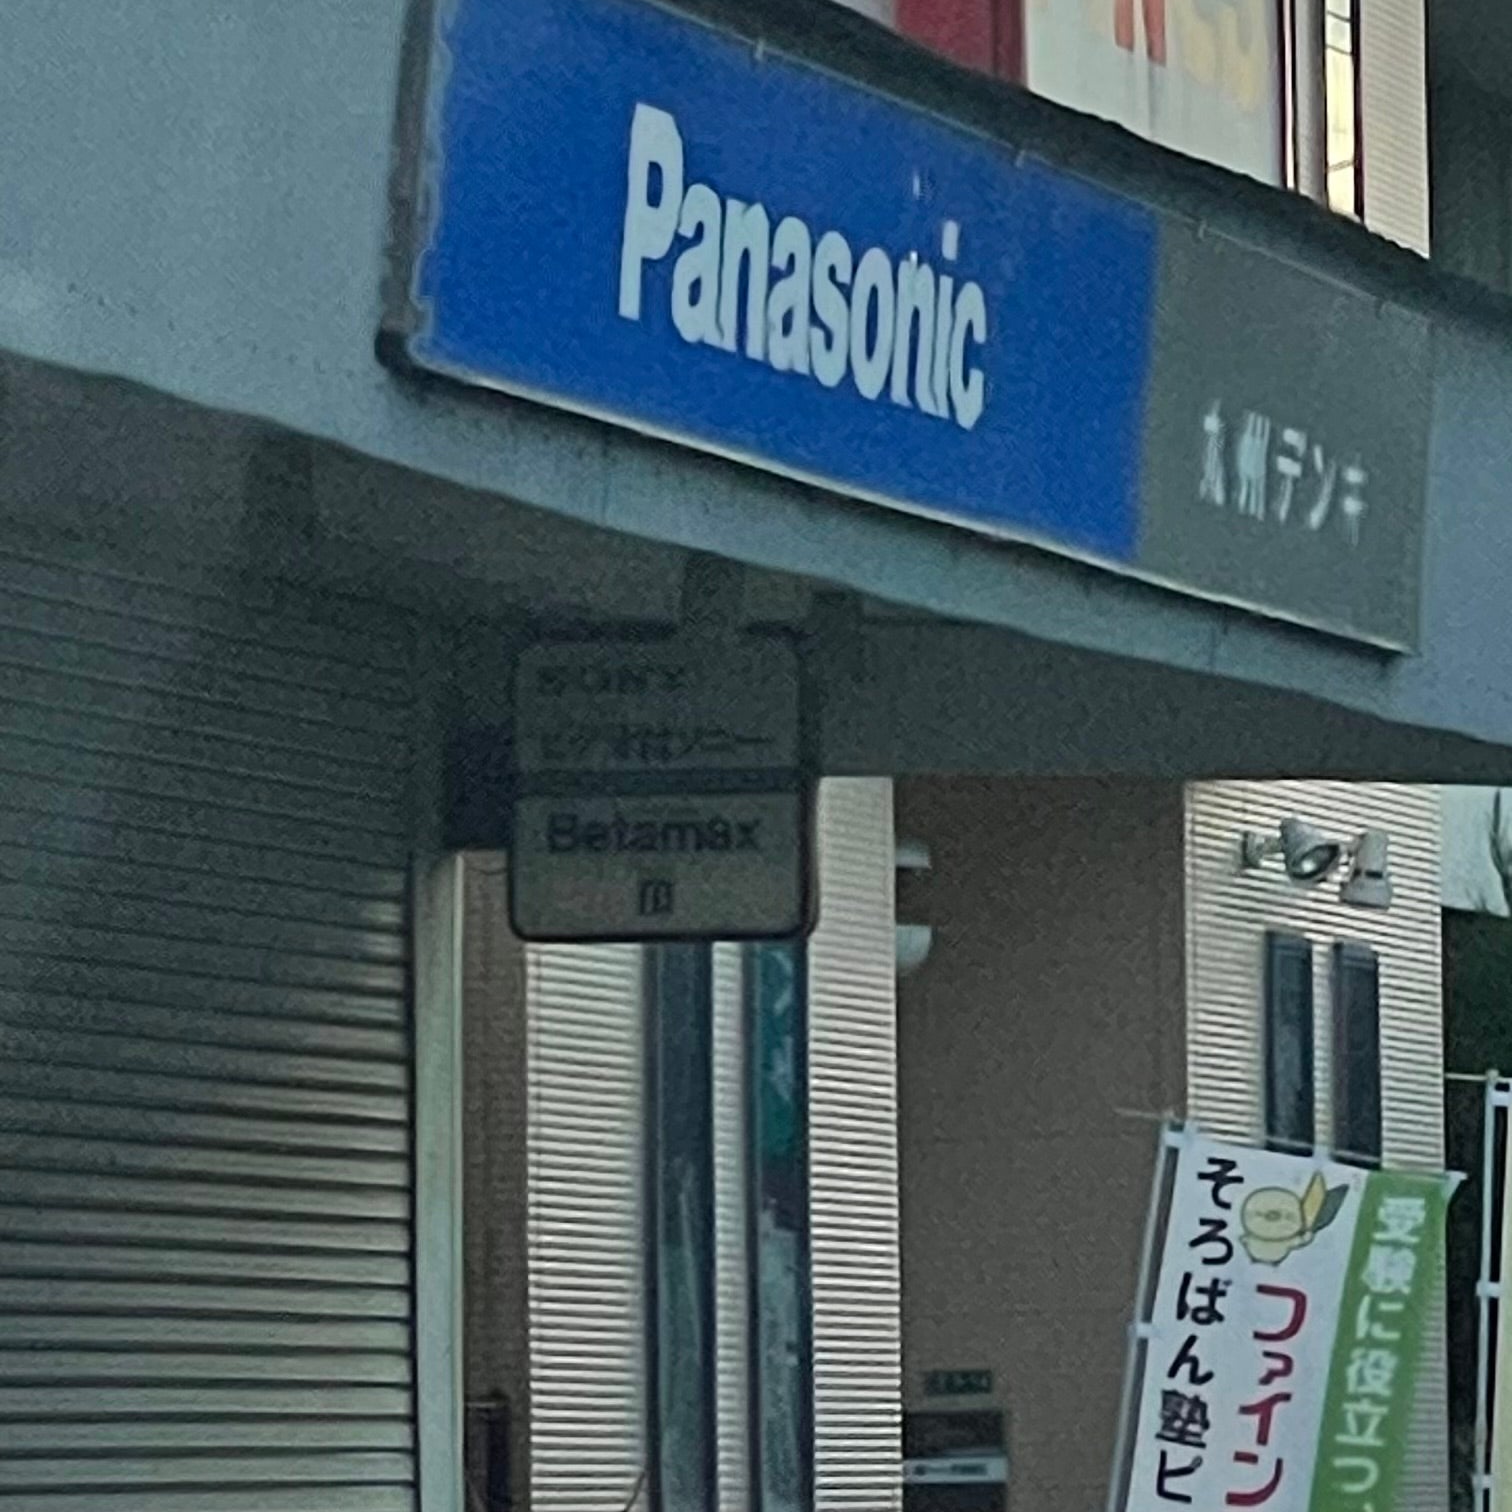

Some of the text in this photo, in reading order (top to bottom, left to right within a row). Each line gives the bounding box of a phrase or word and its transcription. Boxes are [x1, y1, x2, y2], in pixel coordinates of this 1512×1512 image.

[619, 102, 988, 430] Panasonic
[1200, 398, 1368, 547] 九州デンキ
[547, 812, 763, 852] Betamax
[1154, 1157, 1244, 1504] そろばん塾ピ
[1225, 1283, 1308, 1506] ファイン
